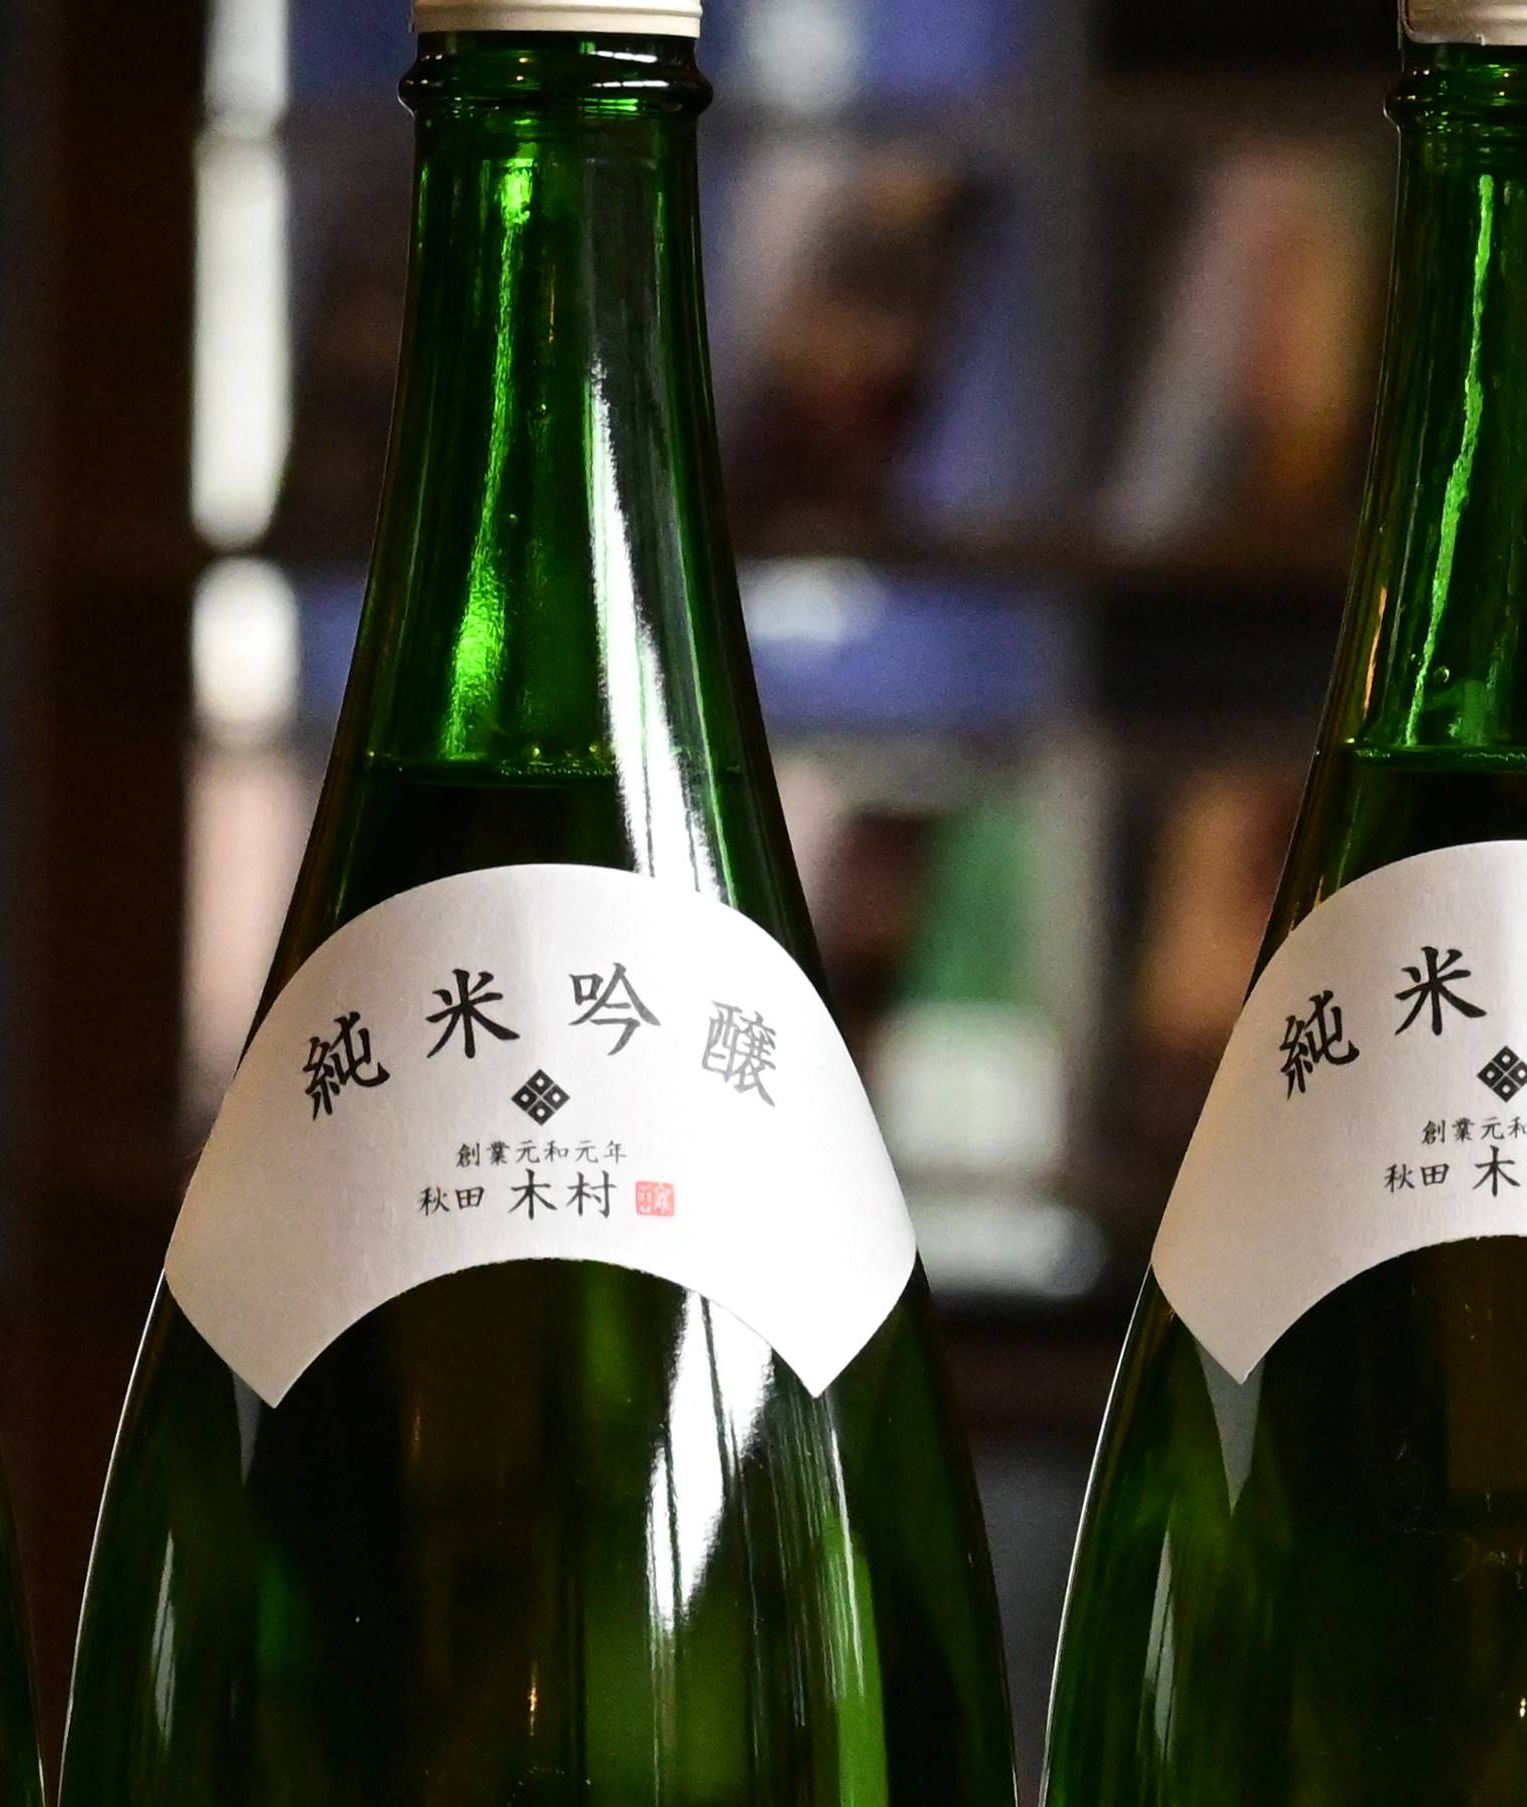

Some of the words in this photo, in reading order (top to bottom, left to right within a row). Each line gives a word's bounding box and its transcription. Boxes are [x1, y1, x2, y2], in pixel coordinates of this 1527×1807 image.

[456, 1140, 628, 1169] 創業元和元年
[418, 1186, 485, 1217] 秋田
[508, 1168, 617, 1221] 木村
[1383, 1163, 1451, 1195] 秋田
